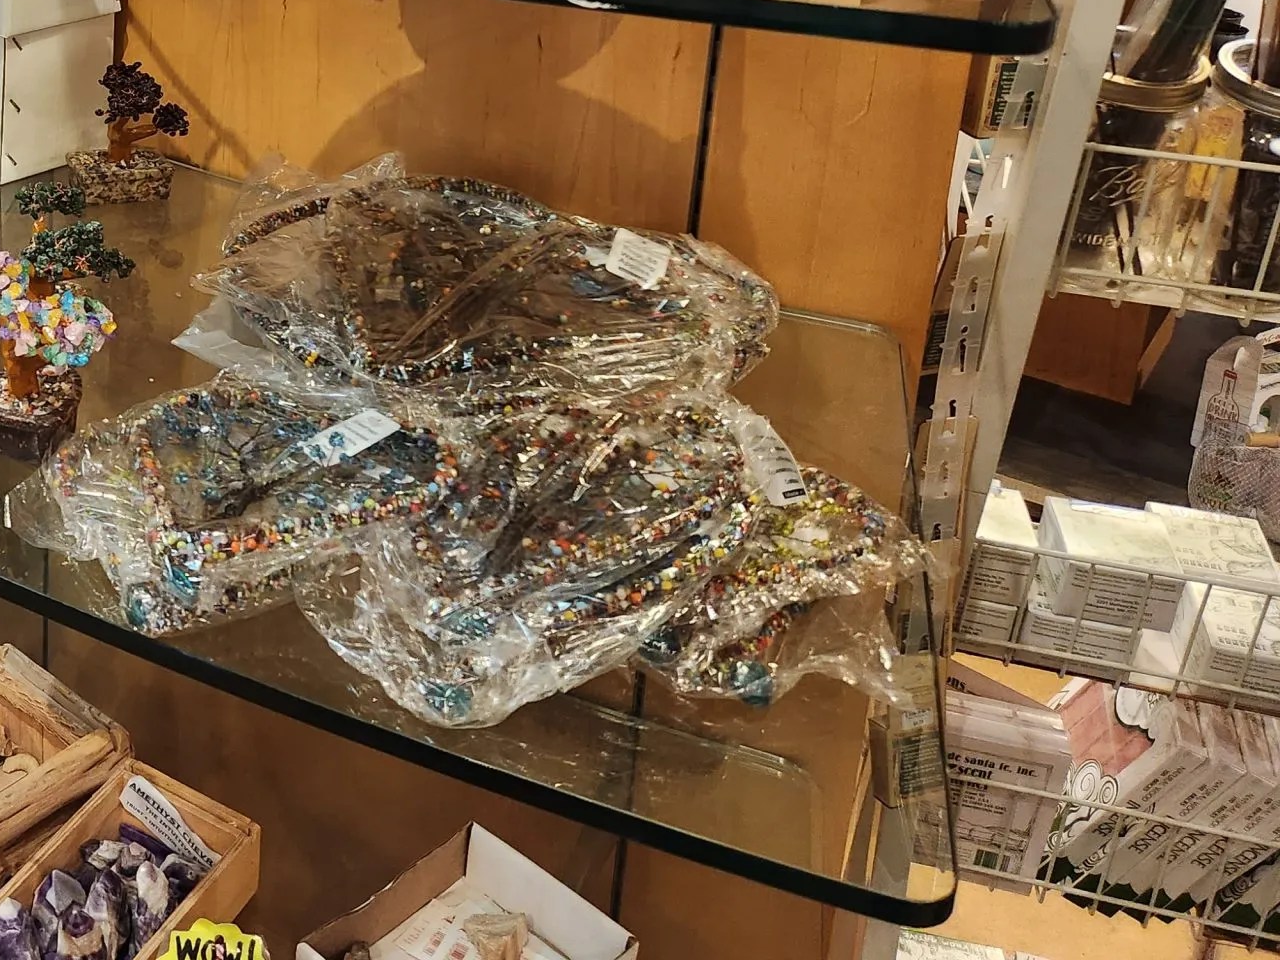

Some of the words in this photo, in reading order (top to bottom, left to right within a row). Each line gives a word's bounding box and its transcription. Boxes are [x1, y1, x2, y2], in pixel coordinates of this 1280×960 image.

[964, 754, 996, 770] santa
[957, 763, 993, 781] scent
[129, 781, 182, 830] AMETHYST
[144, 805, 158, 819] THE
[1178, 800, 1197, 817] WOOD
[1093, 799, 1140, 837] INENSE
